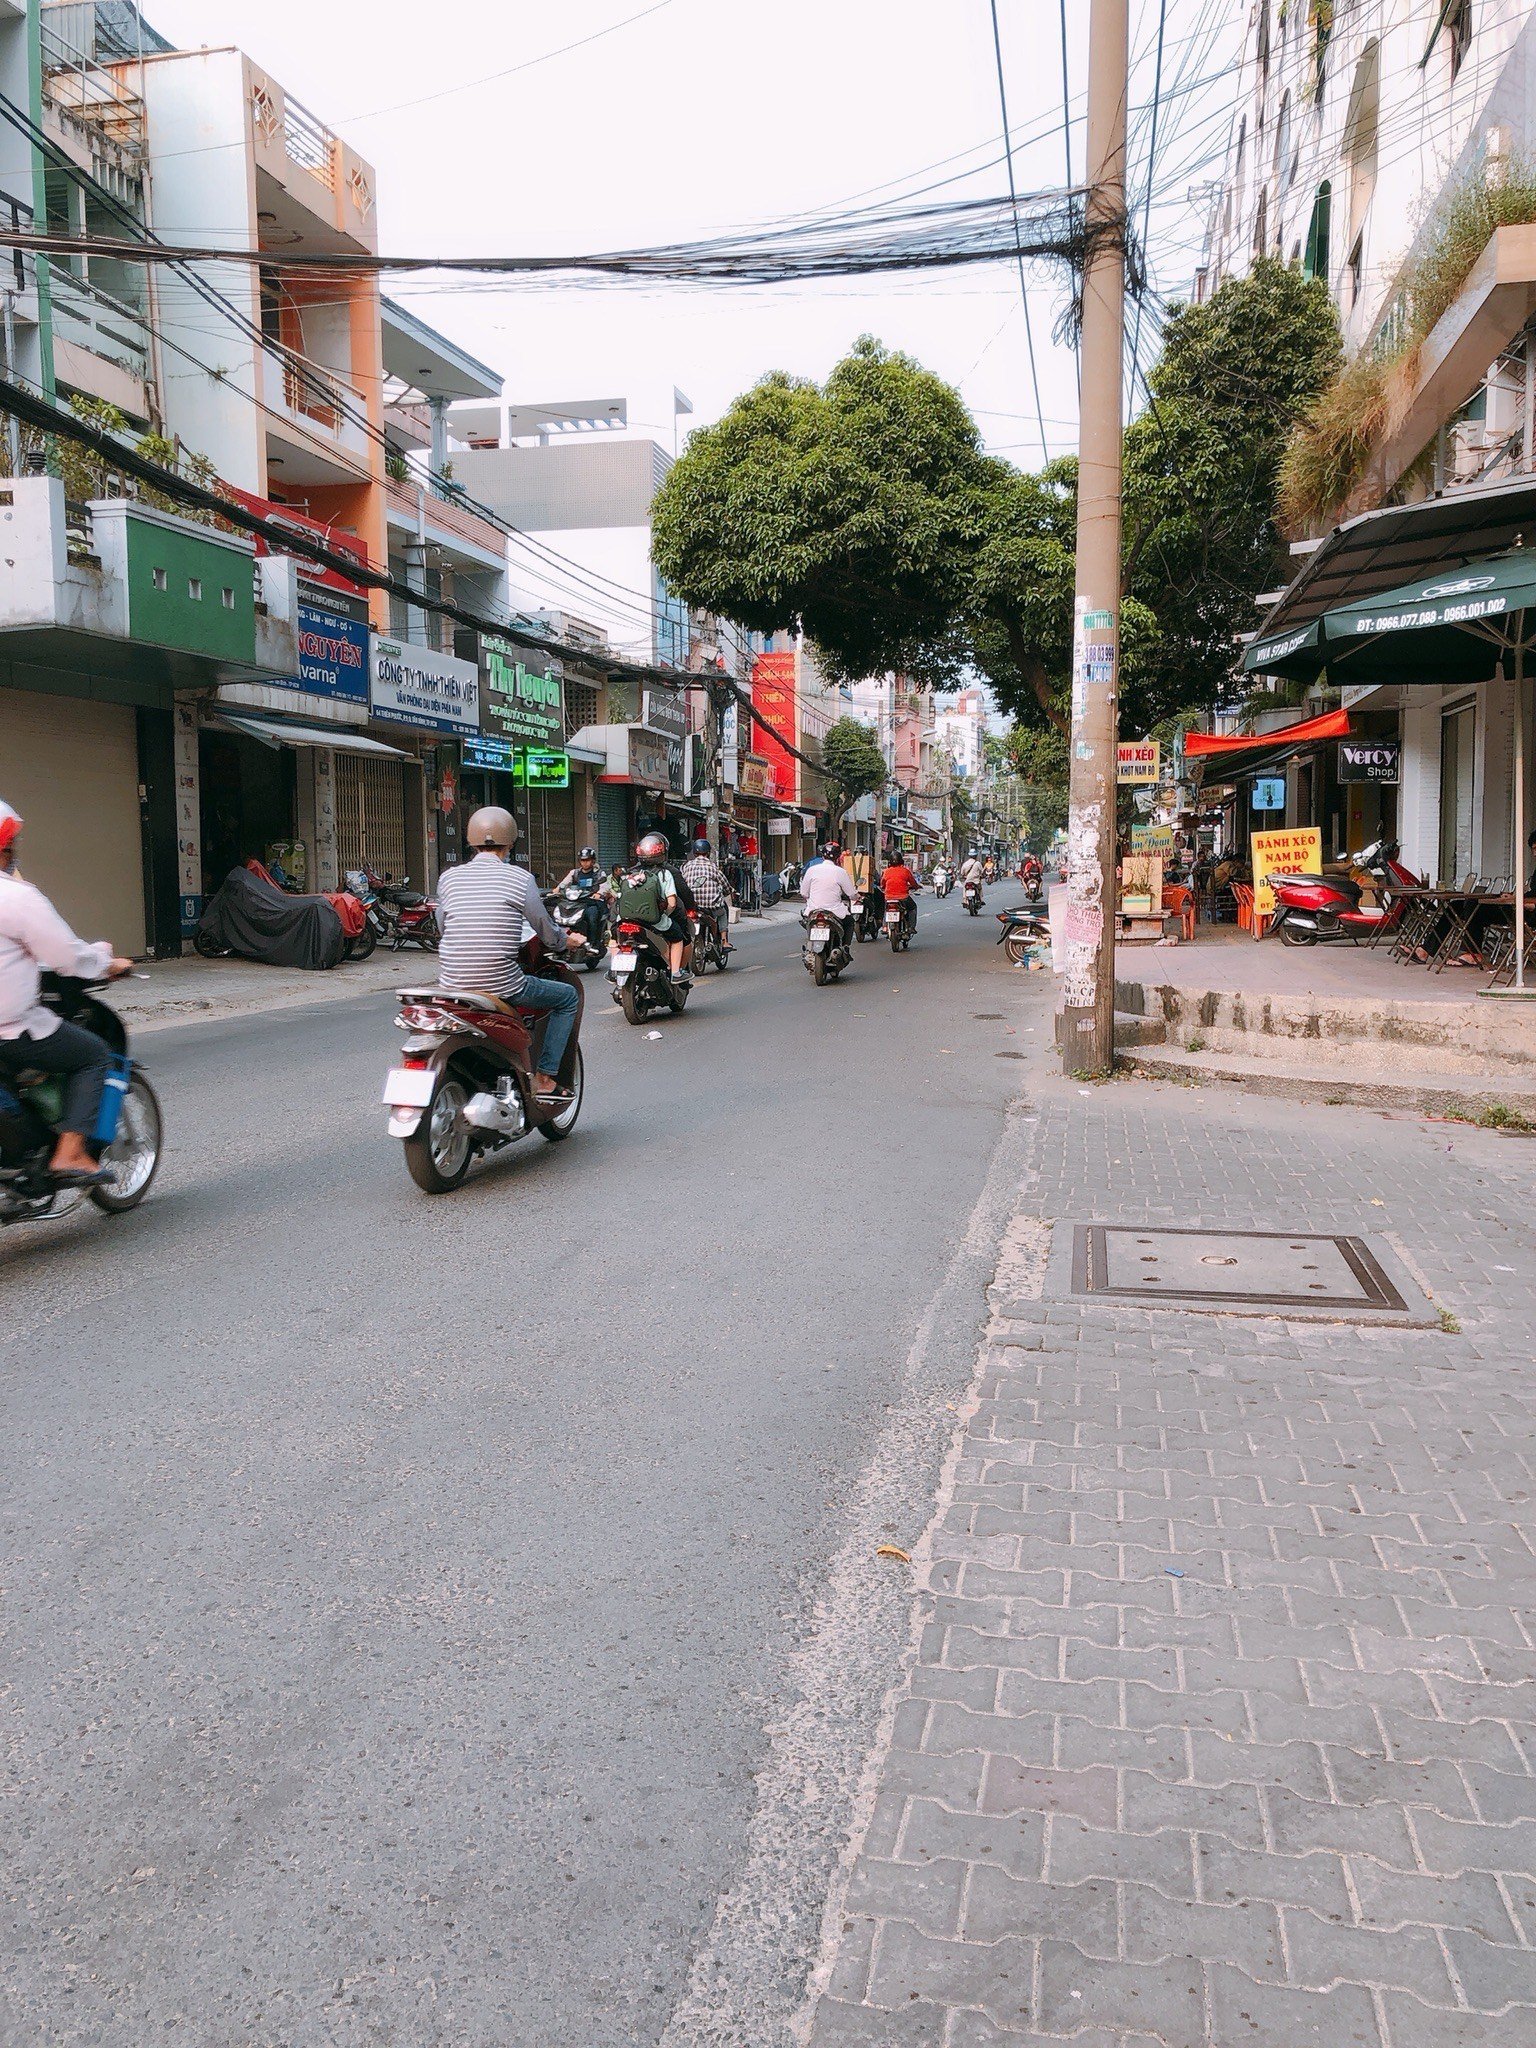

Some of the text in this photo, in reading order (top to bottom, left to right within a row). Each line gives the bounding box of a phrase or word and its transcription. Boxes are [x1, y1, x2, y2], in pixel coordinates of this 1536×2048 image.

[1443, 597, 1507, 622] 0966.001.002
[299, 631, 363, 669] NGUYÊN
[299, 664, 337, 685] varna
[376, 657, 478, 707] CÔNG TY TNHH THIÊN VIỆT
[406, 694, 422, 709] PHÒNG
[451, 706, 462, 716] NAM
[1118, 745, 1154, 761] NH XÈO
[1343, 747, 1396, 766] Vercy
[1134, 765, 1147, 776] NAM
[1367, 766, 1394, 778] Shop
[1257, 834, 1316, 849] BÁNH XÈO
[1265, 848, 1309, 863] NAM BỘ
[1272, 865, 1304, 875] 30K
